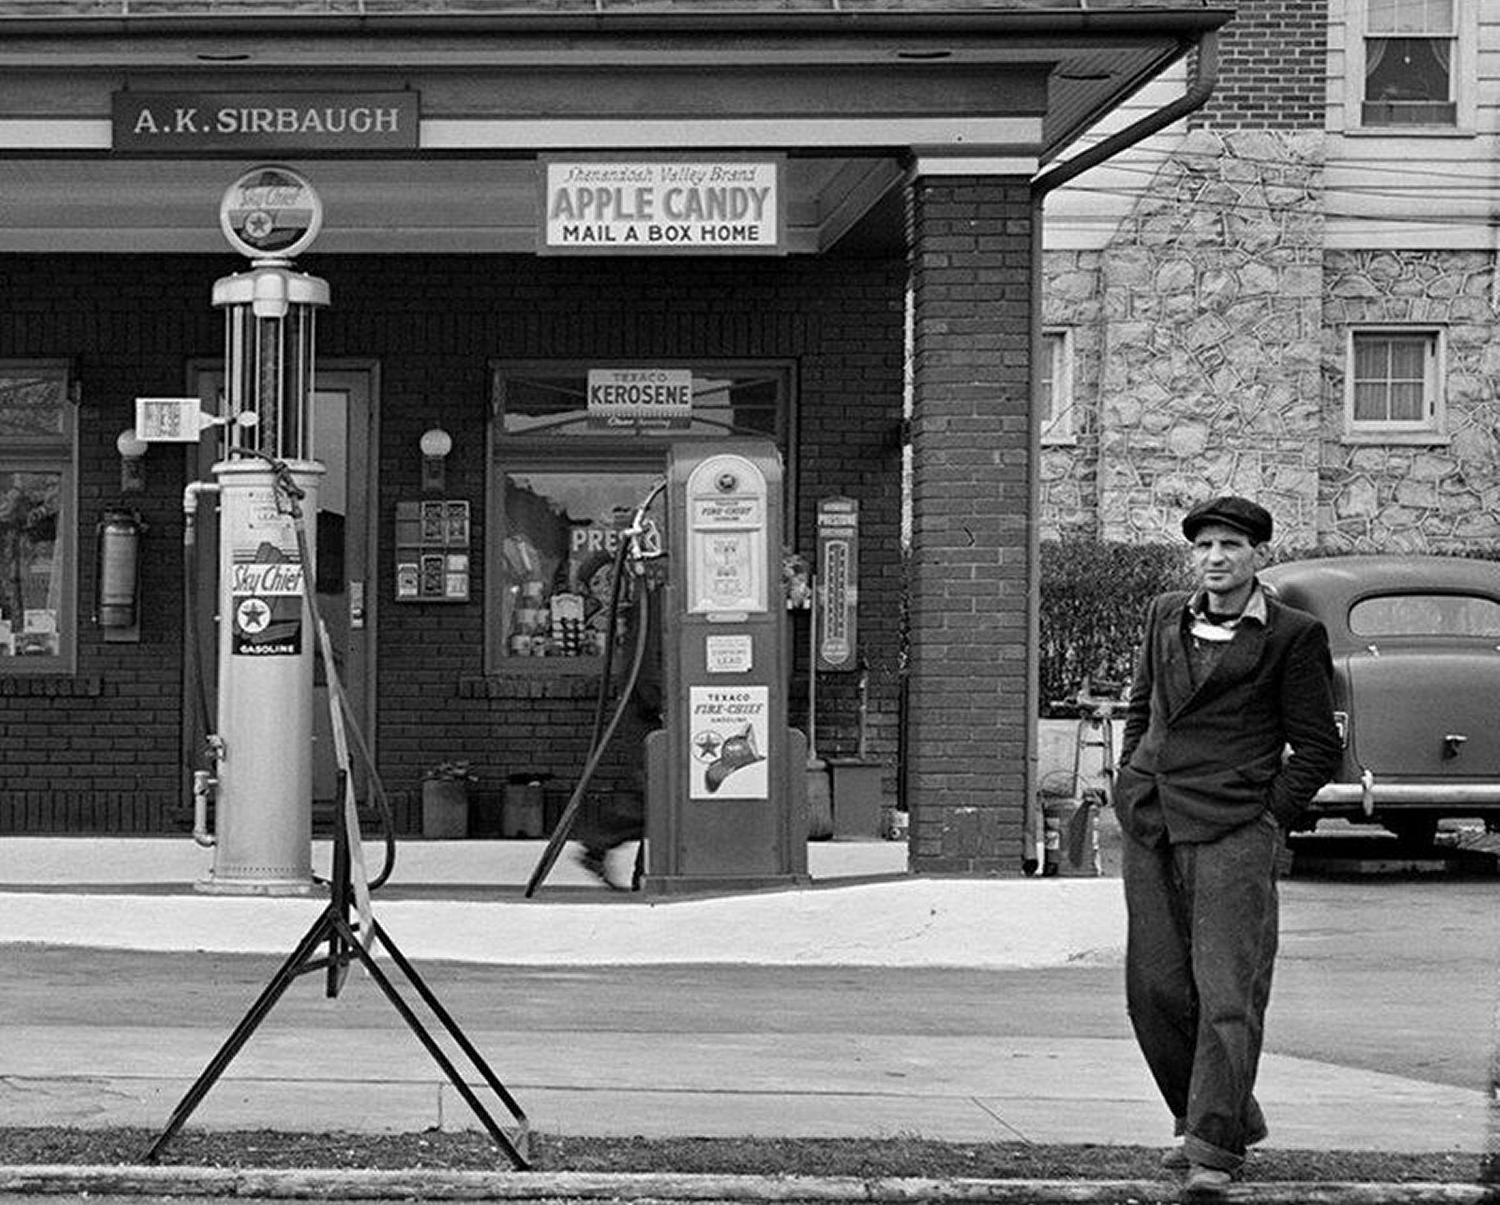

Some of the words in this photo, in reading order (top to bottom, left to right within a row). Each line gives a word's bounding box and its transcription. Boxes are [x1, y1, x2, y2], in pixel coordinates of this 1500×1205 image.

[550, 187, 654, 221] APPLE
[663, 187, 771, 221] CANDY
[563, 225, 616, 242] MAIL
[624, 225, 639, 242] A
[649, 225, 692, 242] BOX
[701, 225, 759, 242] HOME
[590, 384, 690, 405] KEROSENE
[233, 564, 258, 594] Sky
[261, 565, 304, 592] Chief
[239, 645, 295, 654] GASOLINE
[707, 693, 751, 702] TEXACO
